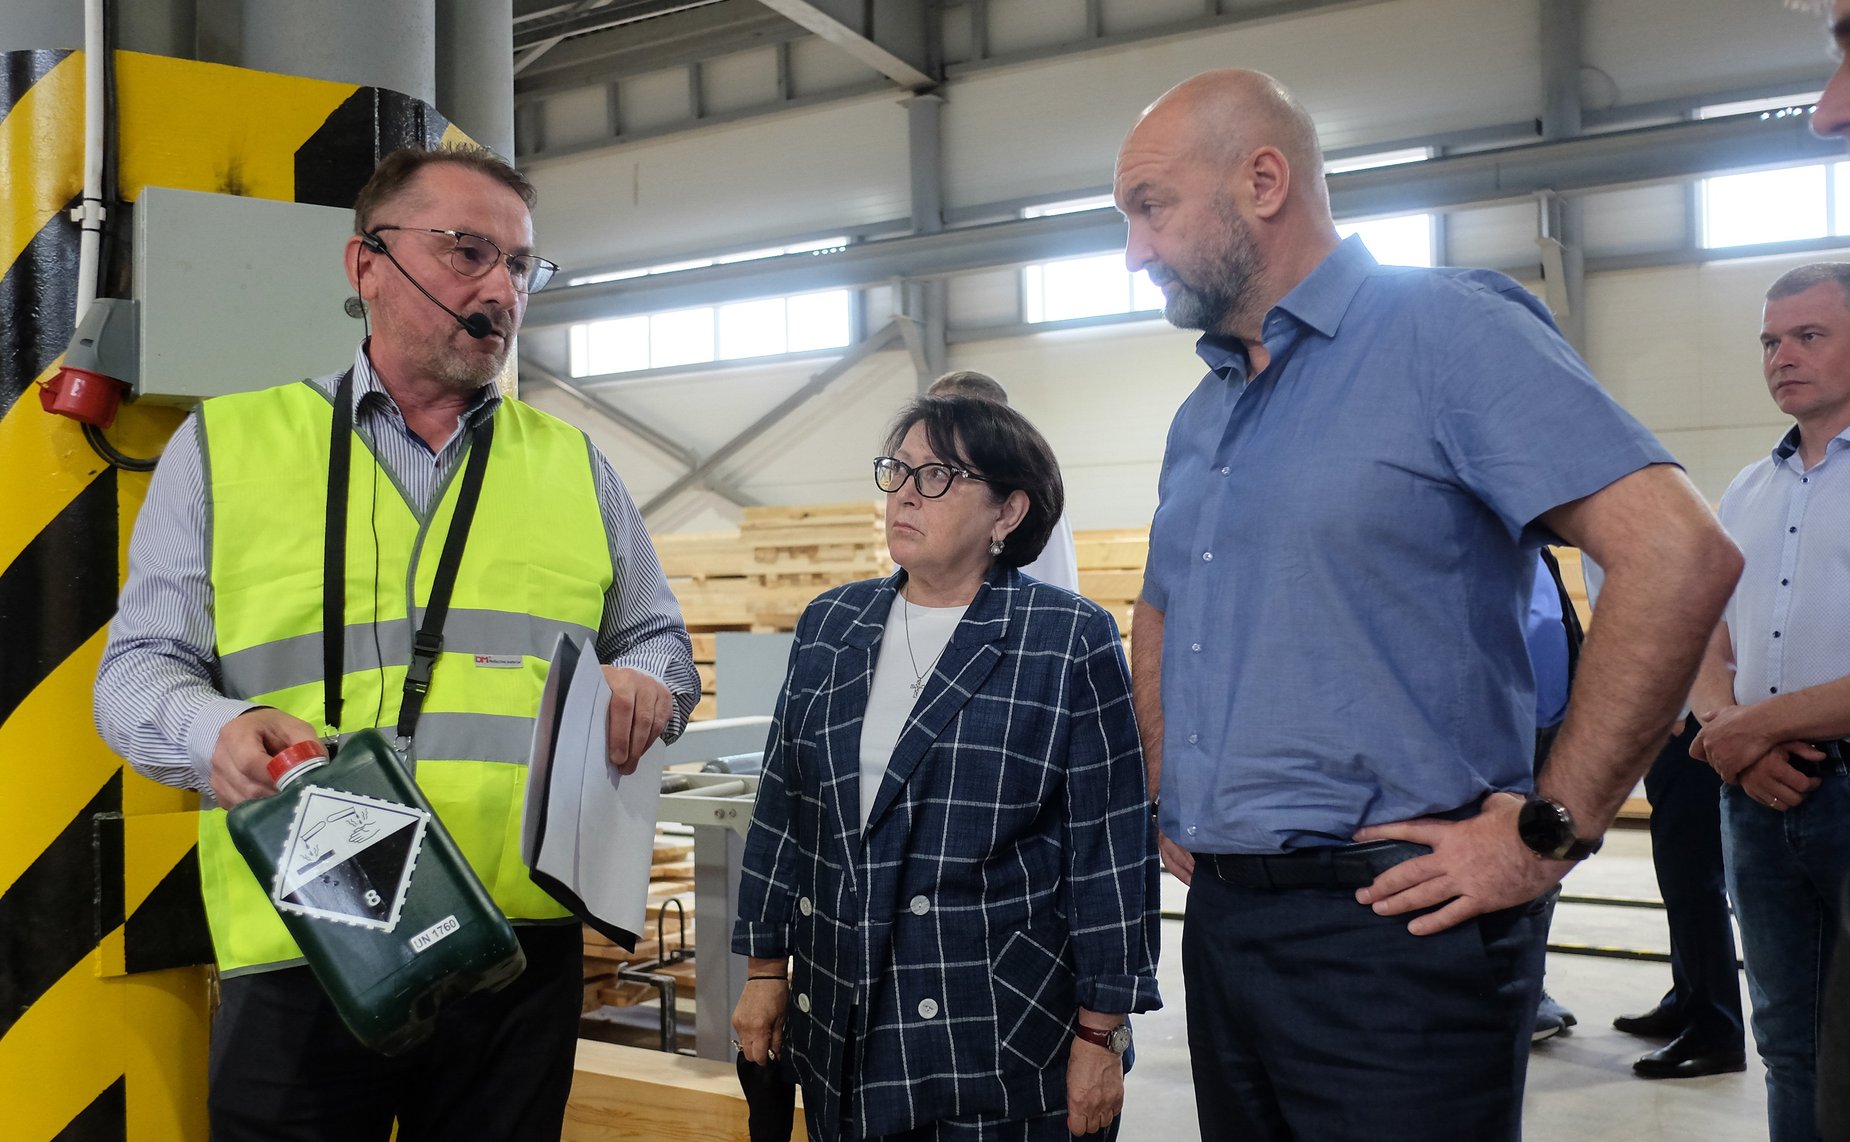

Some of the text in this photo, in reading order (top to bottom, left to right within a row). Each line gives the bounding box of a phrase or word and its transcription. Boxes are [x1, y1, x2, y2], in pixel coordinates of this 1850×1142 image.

[365, 889, 381, 906] 8
[414, 919, 456, 948] UN 1760
